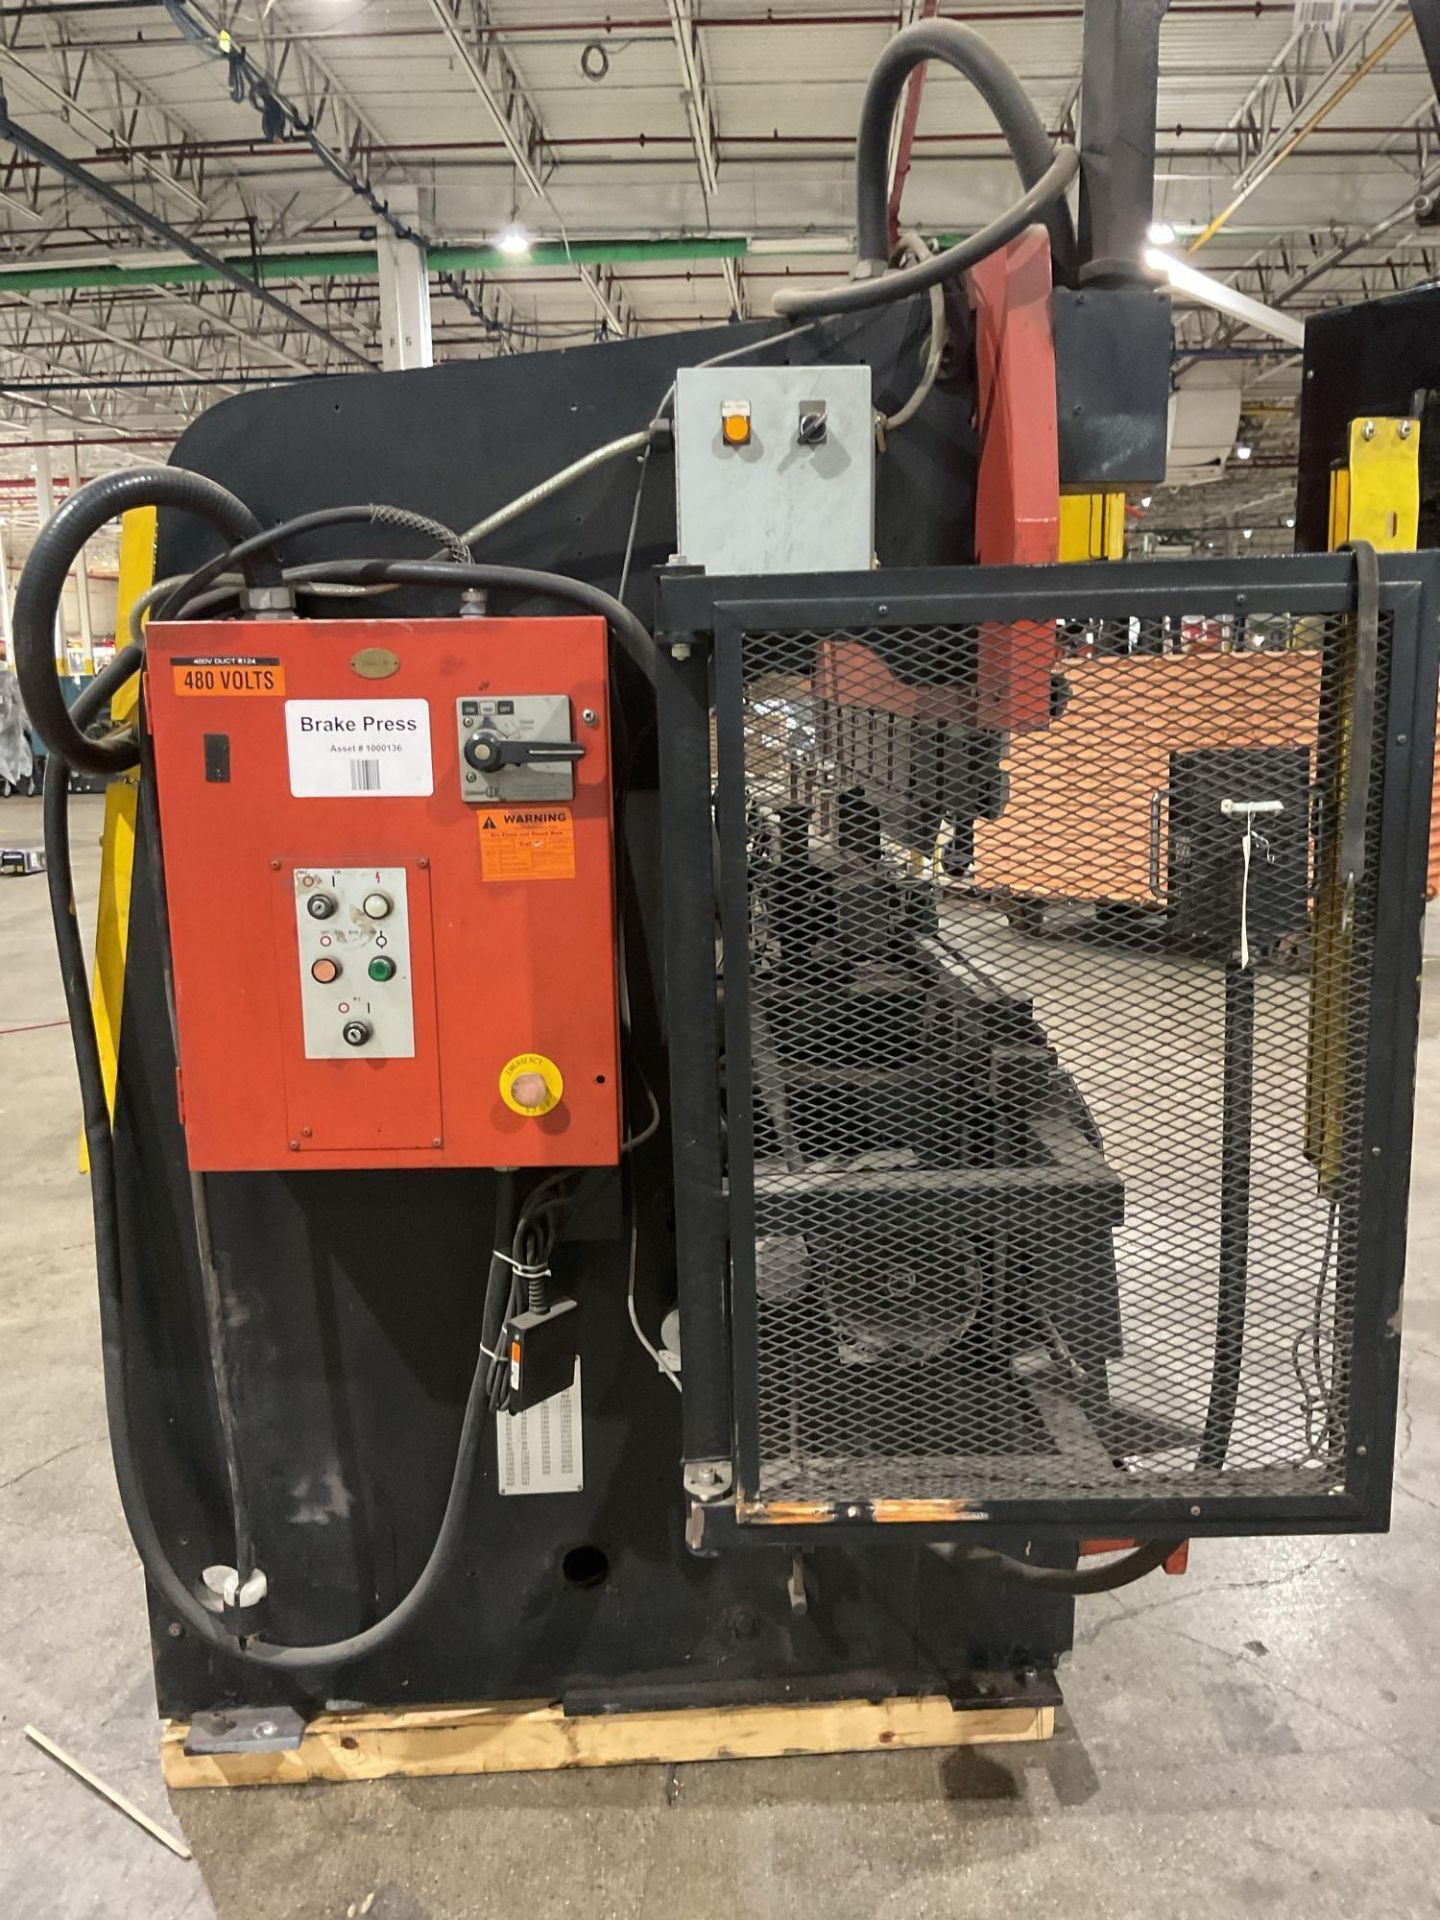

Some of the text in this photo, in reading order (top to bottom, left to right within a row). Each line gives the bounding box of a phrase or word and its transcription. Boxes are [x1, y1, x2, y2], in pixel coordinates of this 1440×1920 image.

[184, 671, 274, 690] 480 VOLTS
[300, 716, 417, 732] Brake Press
[330, 745, 356, 753] Asset
[366, 744, 402, 753] 1000136
[504, 813, 567, 824] WARNING
